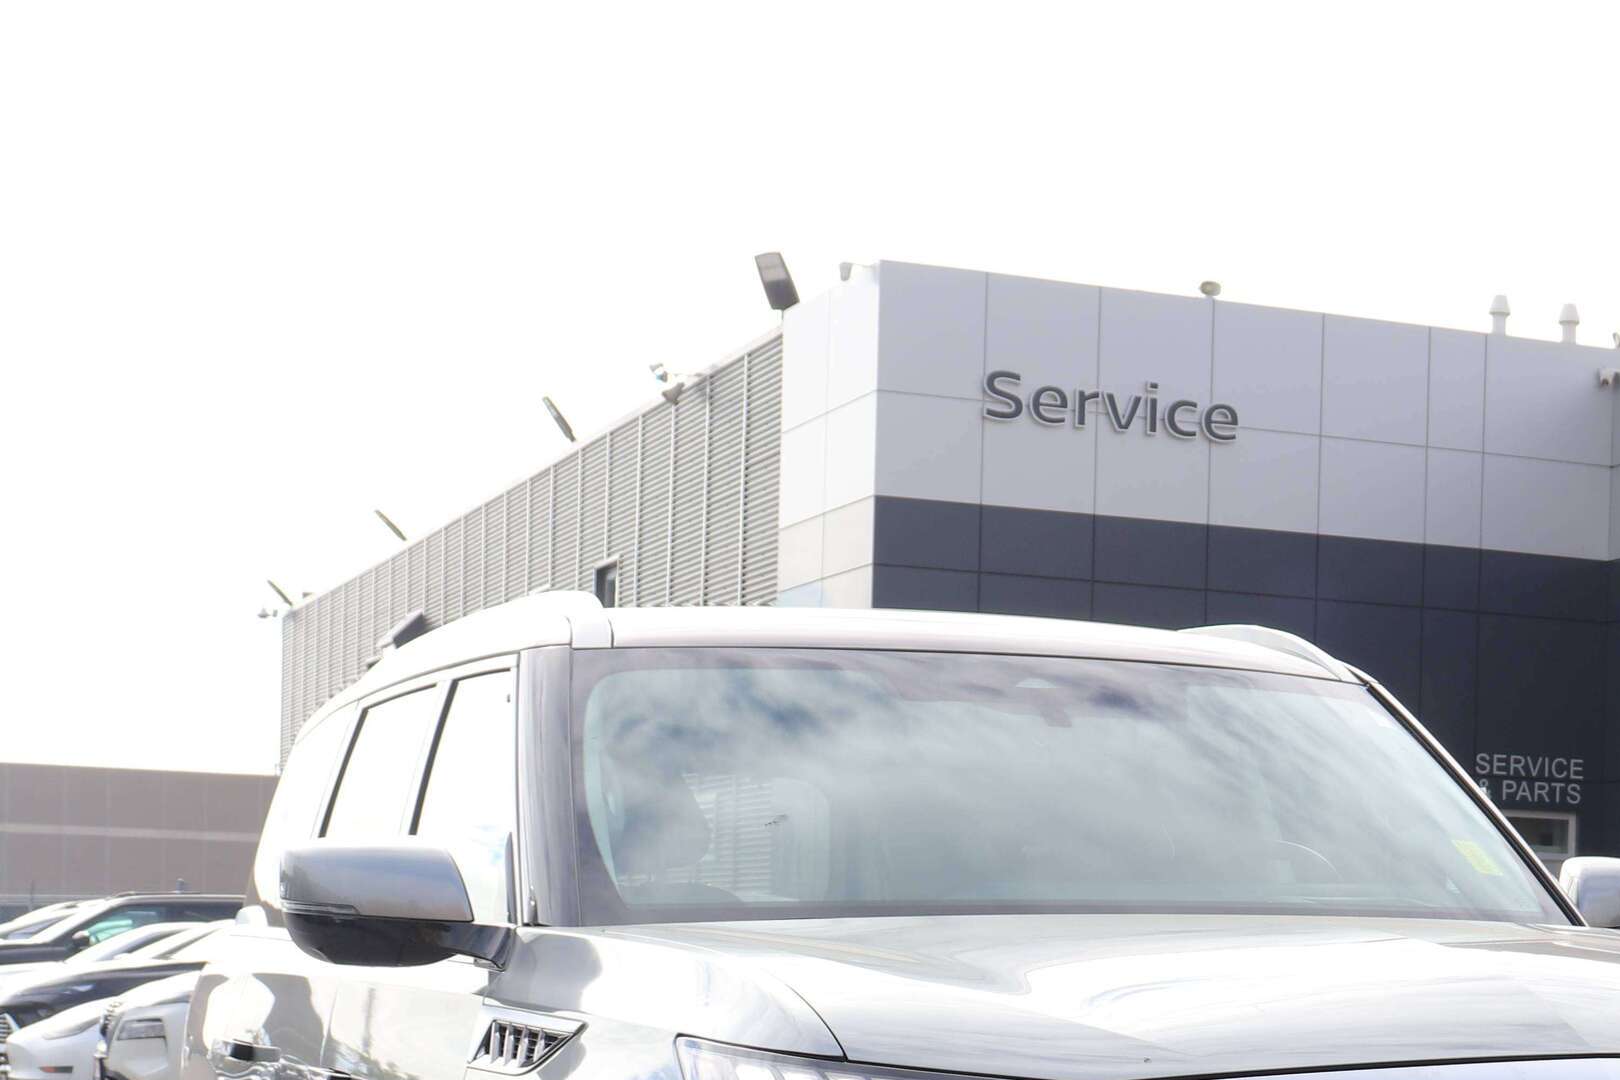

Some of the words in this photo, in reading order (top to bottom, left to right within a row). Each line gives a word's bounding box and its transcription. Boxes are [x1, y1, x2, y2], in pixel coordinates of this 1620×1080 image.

[984, 369, 1239, 442] Service
[1475, 753, 1584, 780] SERVICE
[1502, 780, 1581, 804] PARTS
